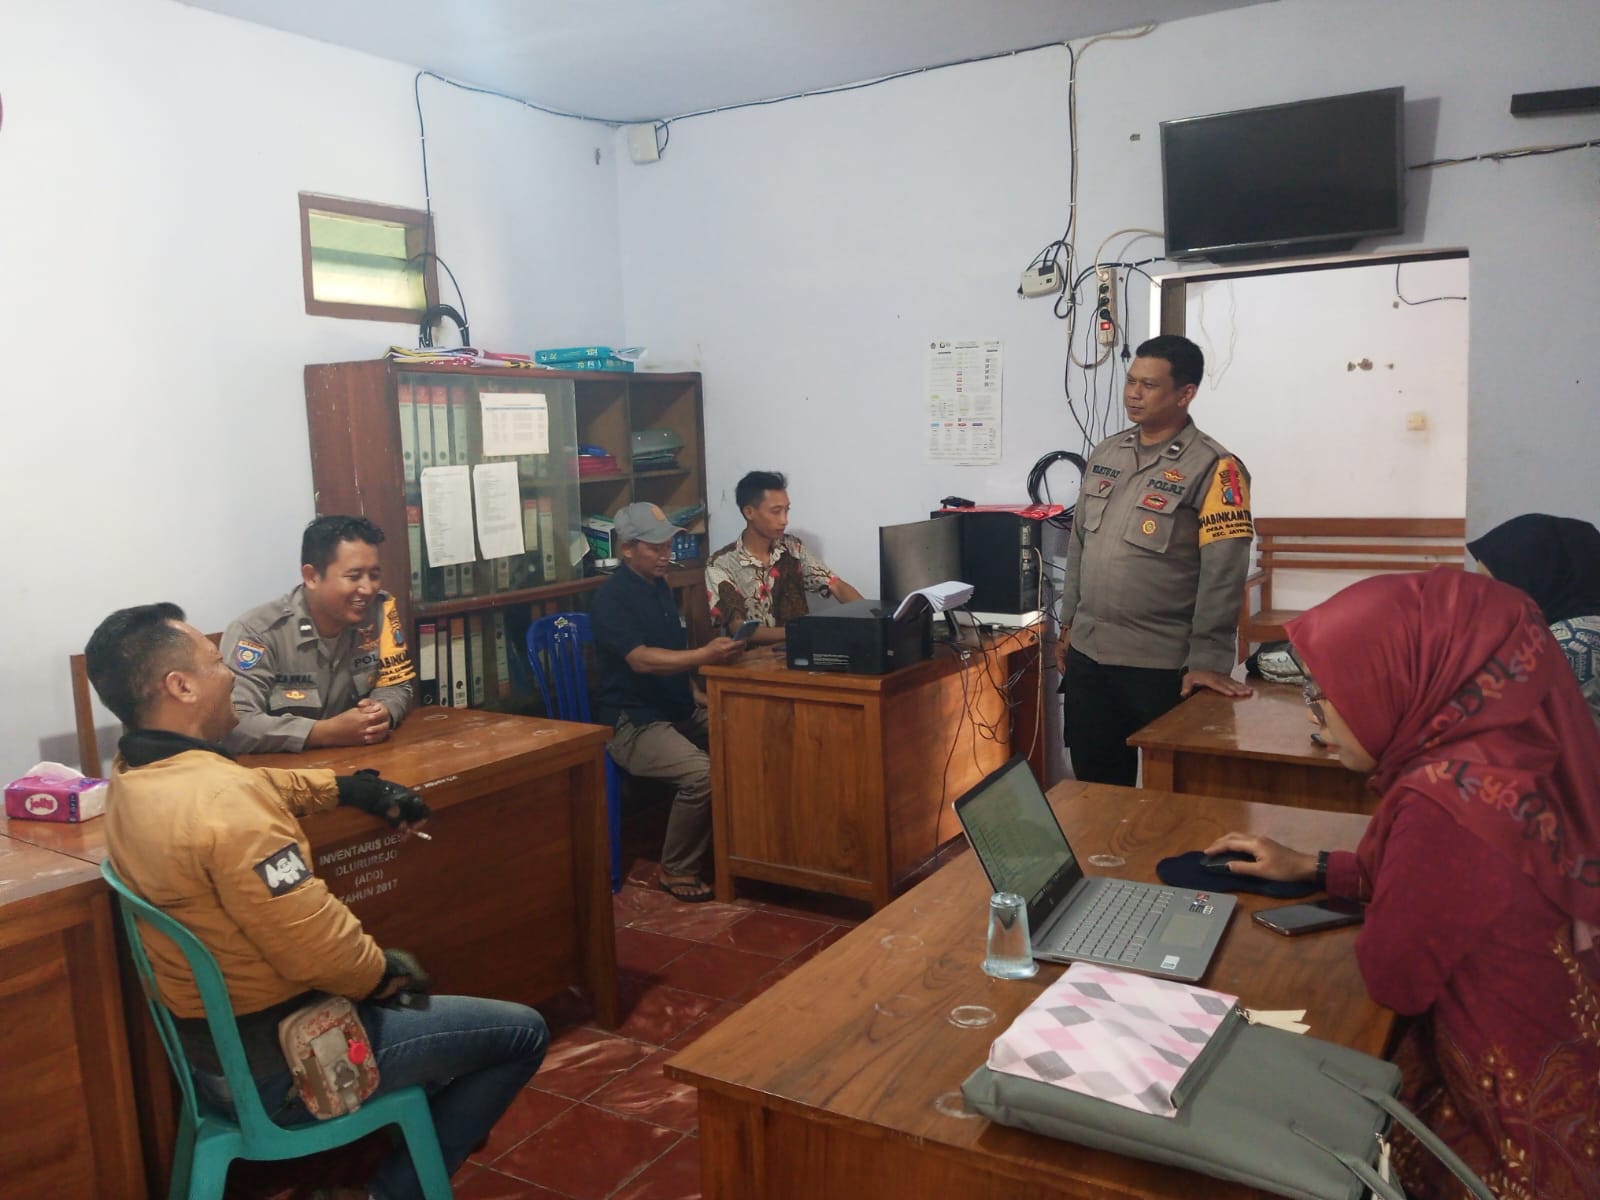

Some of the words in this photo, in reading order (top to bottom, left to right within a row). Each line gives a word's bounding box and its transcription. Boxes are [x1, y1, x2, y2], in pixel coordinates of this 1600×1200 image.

[1147, 479, 1186, 496] POLRI
[319, 839, 382, 865] INVENTARIS
[375, 878, 399, 894] 2017
